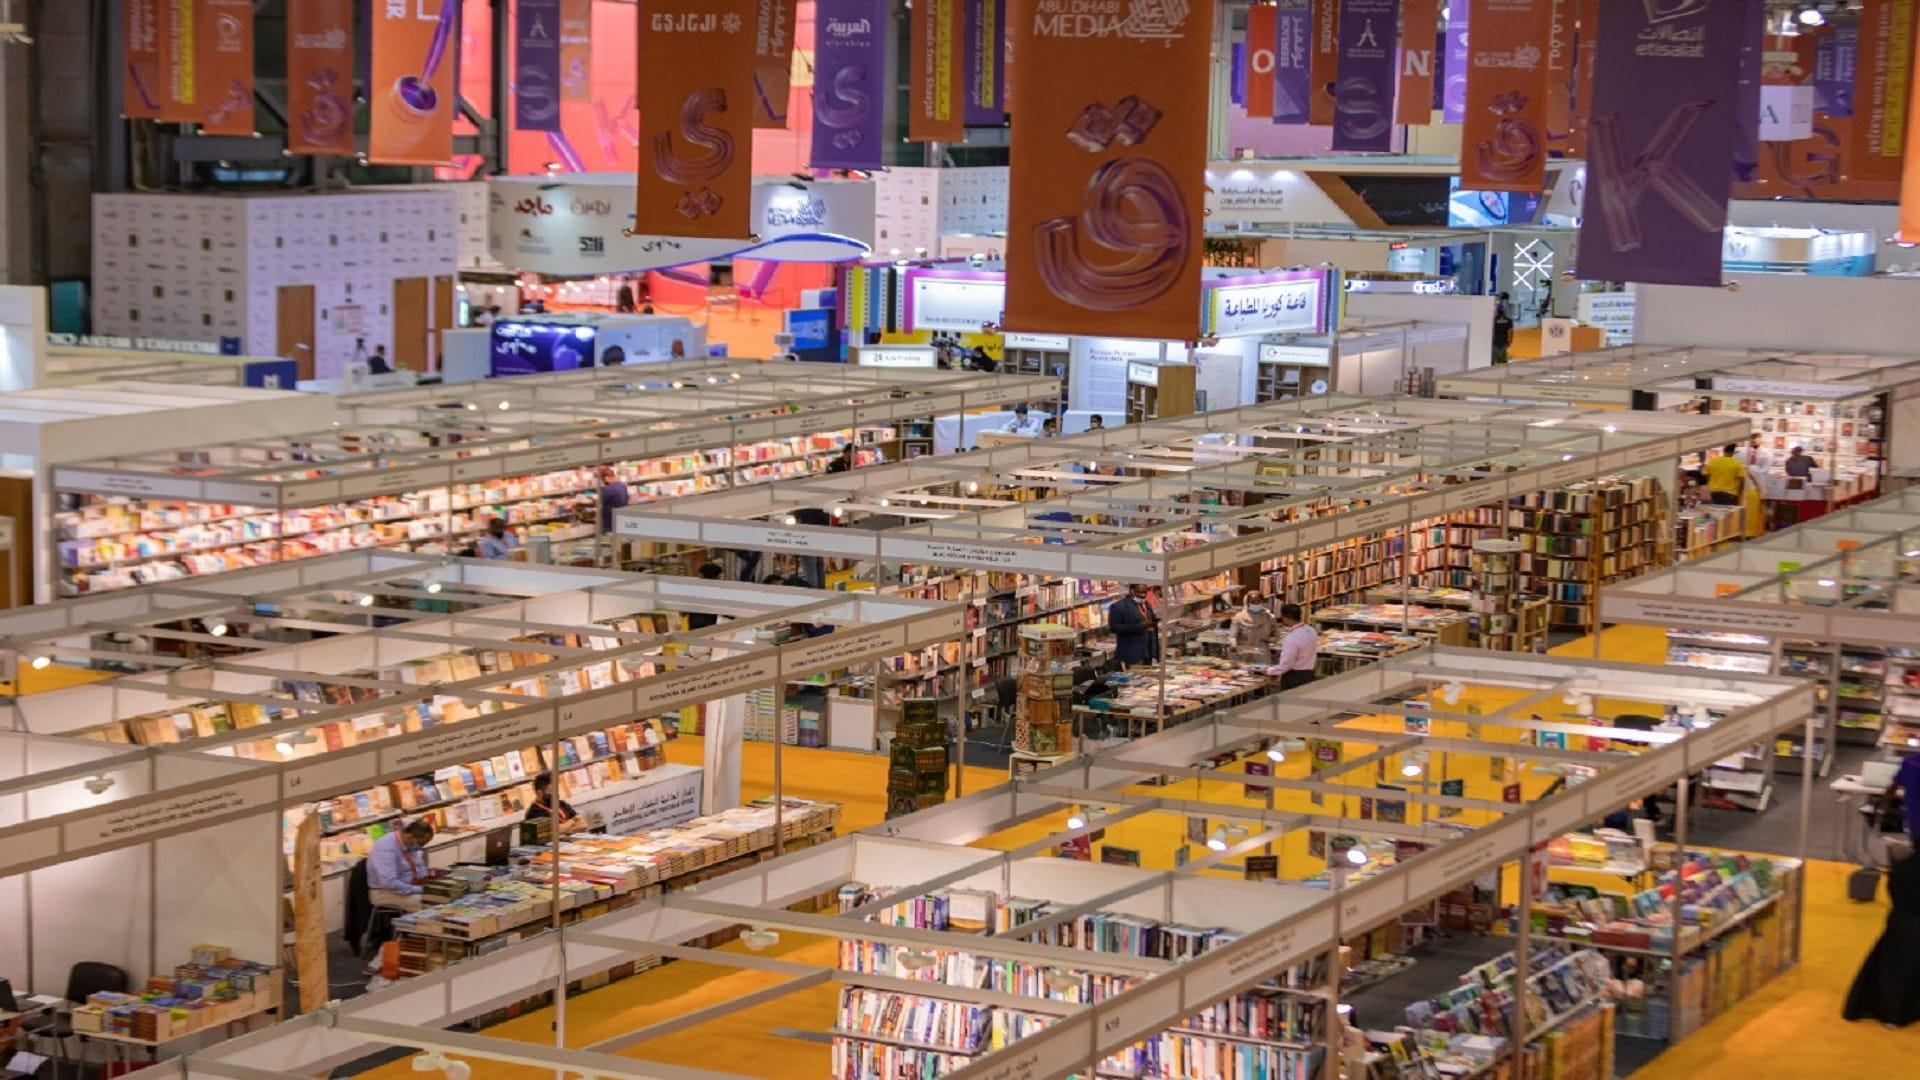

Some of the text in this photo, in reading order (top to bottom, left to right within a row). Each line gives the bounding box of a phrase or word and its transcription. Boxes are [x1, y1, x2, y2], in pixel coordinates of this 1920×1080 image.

[1036, 0, 1120, 14] ABU DHABI
[826, 17, 871, 39] العربية
[1033, 15, 1123, 38] MEDIA
[1637, 24, 1706, 42] اتصالات
[1635, 42, 1706, 58] etisalat
[1402, 50, 1432, 77] N
[1866, 3, 1891, 154] world reads from Sharjah
[514, 196, 555, 218] ماجد
